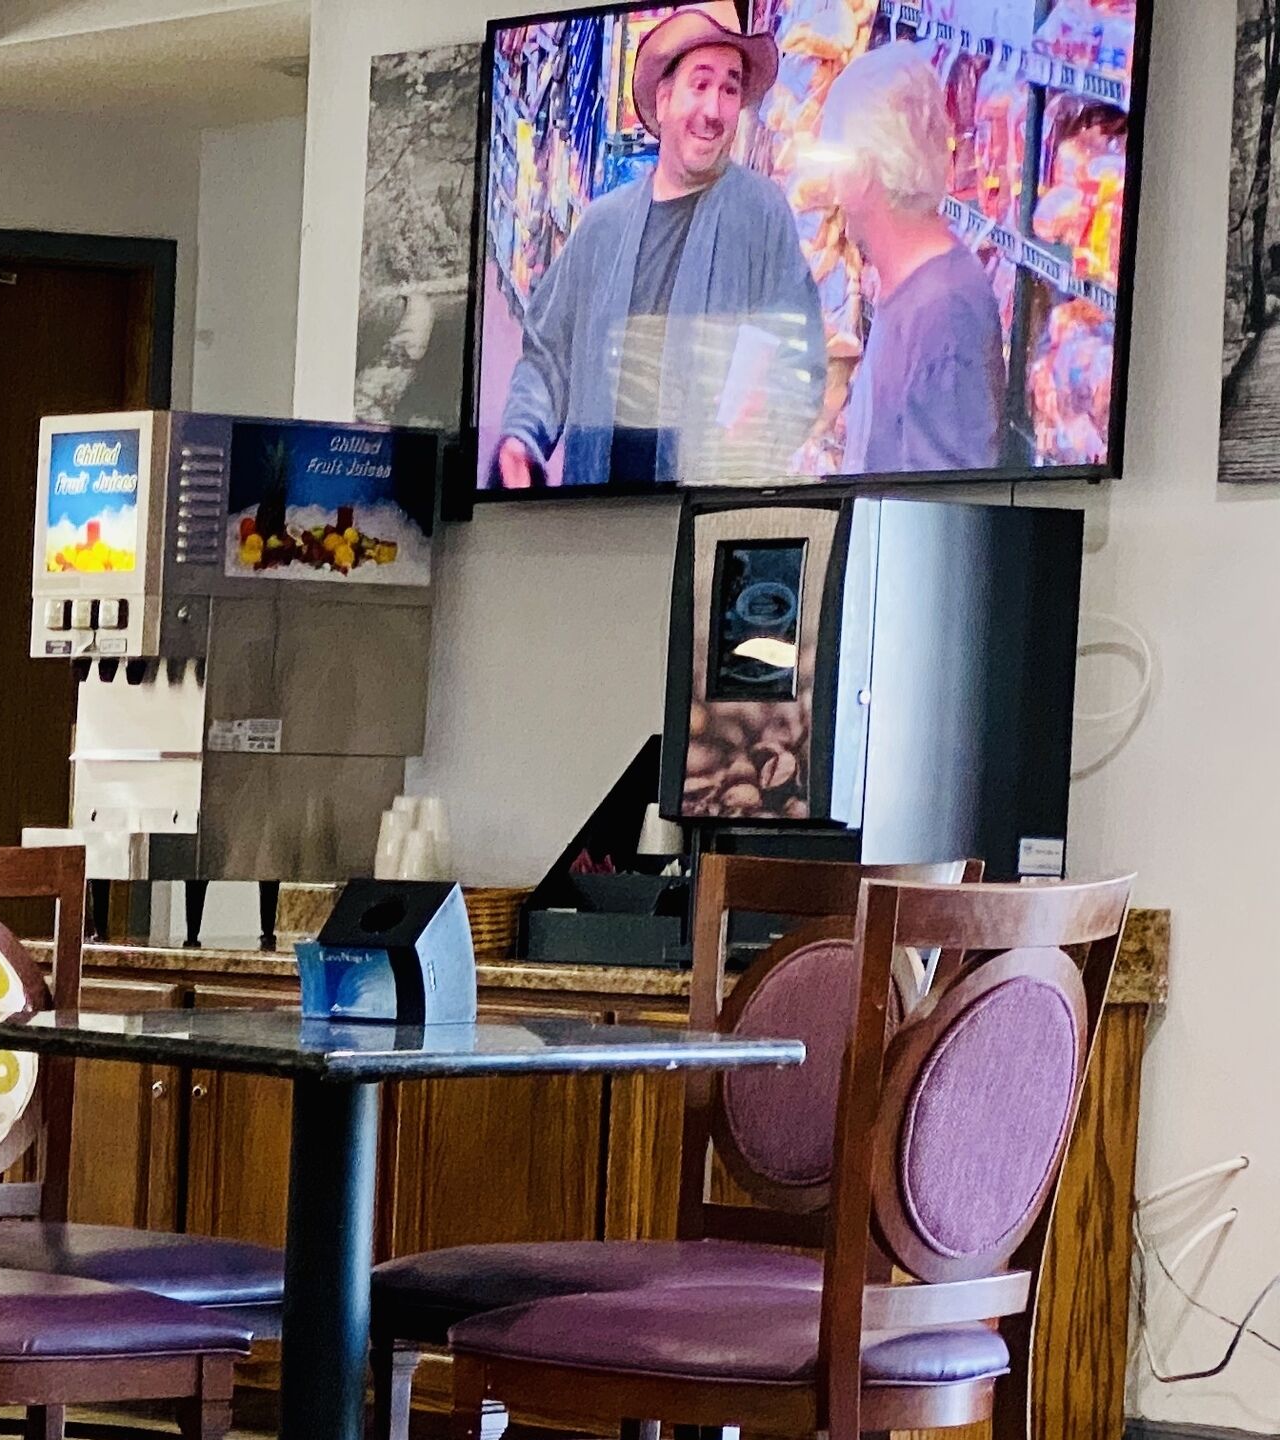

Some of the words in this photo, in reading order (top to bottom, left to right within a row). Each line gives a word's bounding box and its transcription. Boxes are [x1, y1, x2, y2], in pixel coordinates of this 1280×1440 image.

[72, 441, 122, 467] Chilled
[329, 435, 383, 455] Chilled
[306, 457, 343, 475] Fruit
[344, 458, 392, 478] Juices
[54, 471, 90, 495] Fruit
[92, 468, 138, 493] Juices
